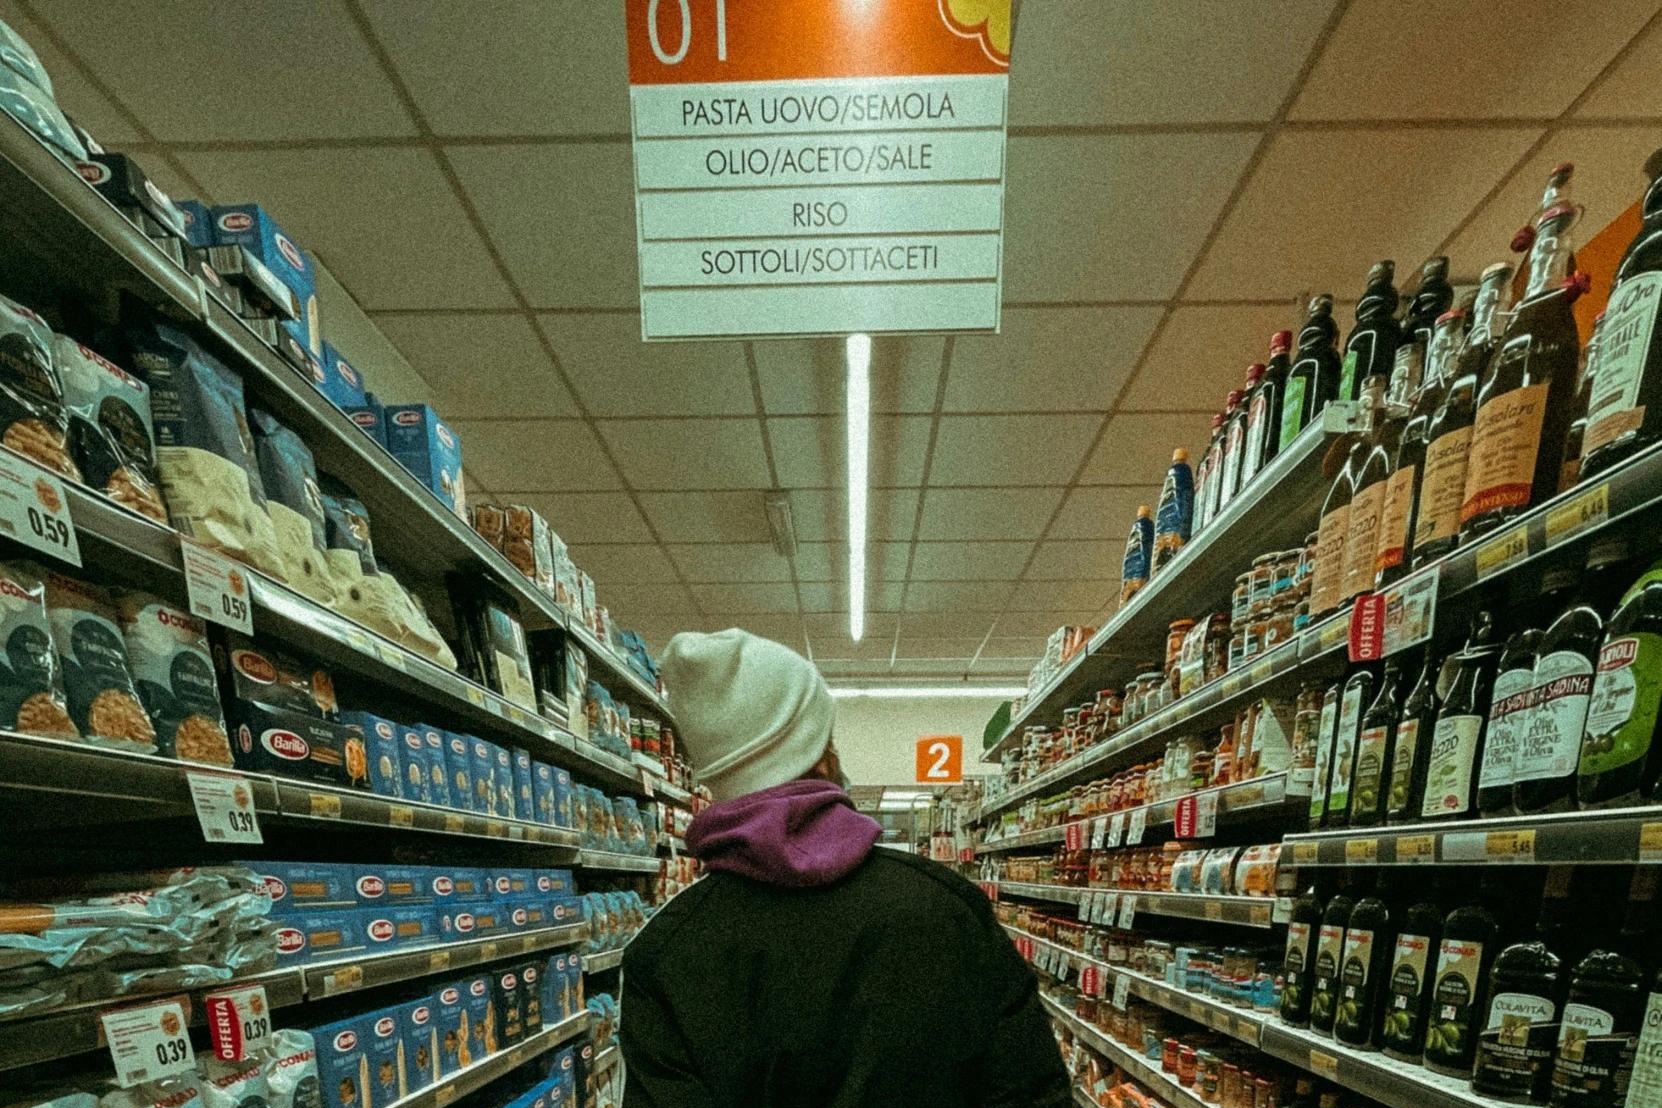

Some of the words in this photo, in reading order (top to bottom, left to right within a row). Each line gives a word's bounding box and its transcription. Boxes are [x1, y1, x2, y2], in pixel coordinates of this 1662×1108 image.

[648, 0, 726, 65] 01
[682, 99, 752, 126] PASTA
[761, 92, 954, 124] UOVO/SEMOLA
[705, 143, 933, 177] OLIO/ACETO/SALE
[792, 202, 848, 227] RISO
[701, 245, 938, 275] SOTTOLI/SOTTACETI
[1359, 598, 1377, 659] OFFERTA
[274, 736, 306, 754] Barilla
[927, 742, 949, 778] 2
[1495, 1000, 1546, 1016] COLAVITA
[214, 1000, 236, 1060] OFFERTA
